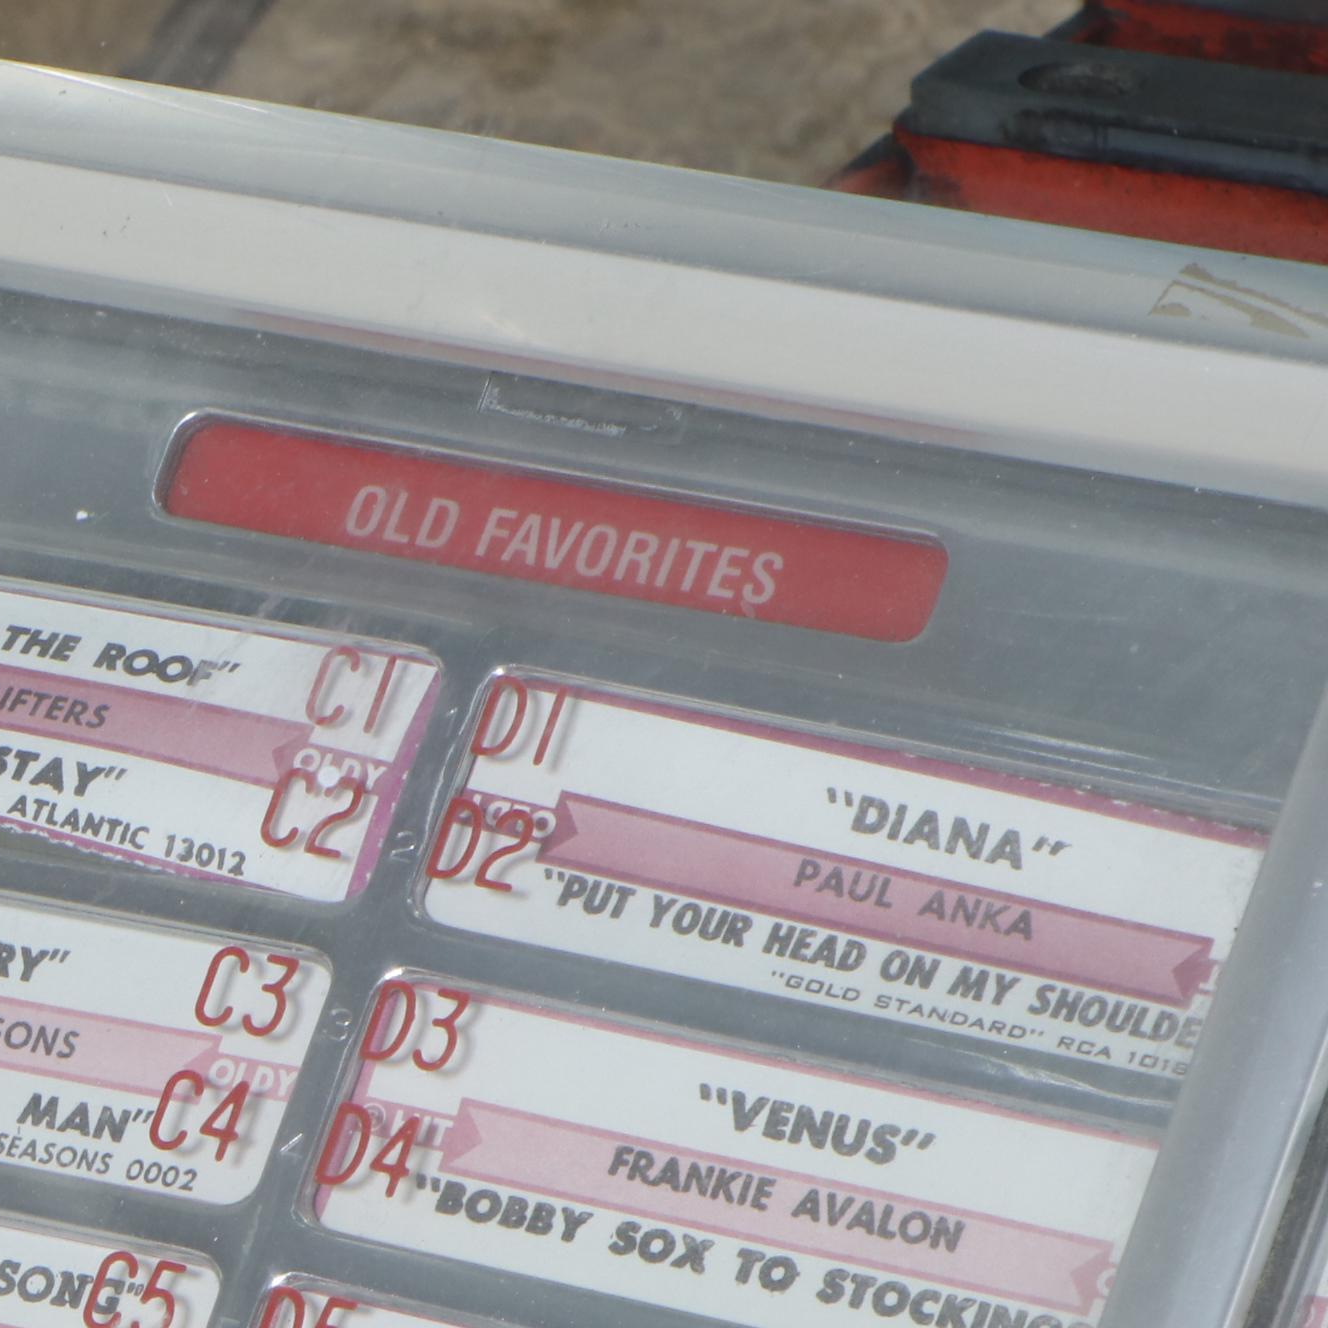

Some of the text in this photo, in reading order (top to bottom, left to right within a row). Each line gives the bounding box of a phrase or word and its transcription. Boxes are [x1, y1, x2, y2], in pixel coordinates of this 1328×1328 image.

[347, 483, 785, 607] OLD FAVORITES
[5, 797, 248, 879] ATLANTIC 13012
[826, 787, 1070, 870] "DIANA"
[793, 858, 1032, 941] PAUL ANKA
[197, 948, 297, 1035] C3
[362, 981, 469, 1070] D3
[151, 1069, 248, 1157] C4
[699, 1083, 936, 1165] "VENUS"
[125, 1159, 197, 1191] 0002
[608, 1145, 965, 1252] FRANKIE AVALON
